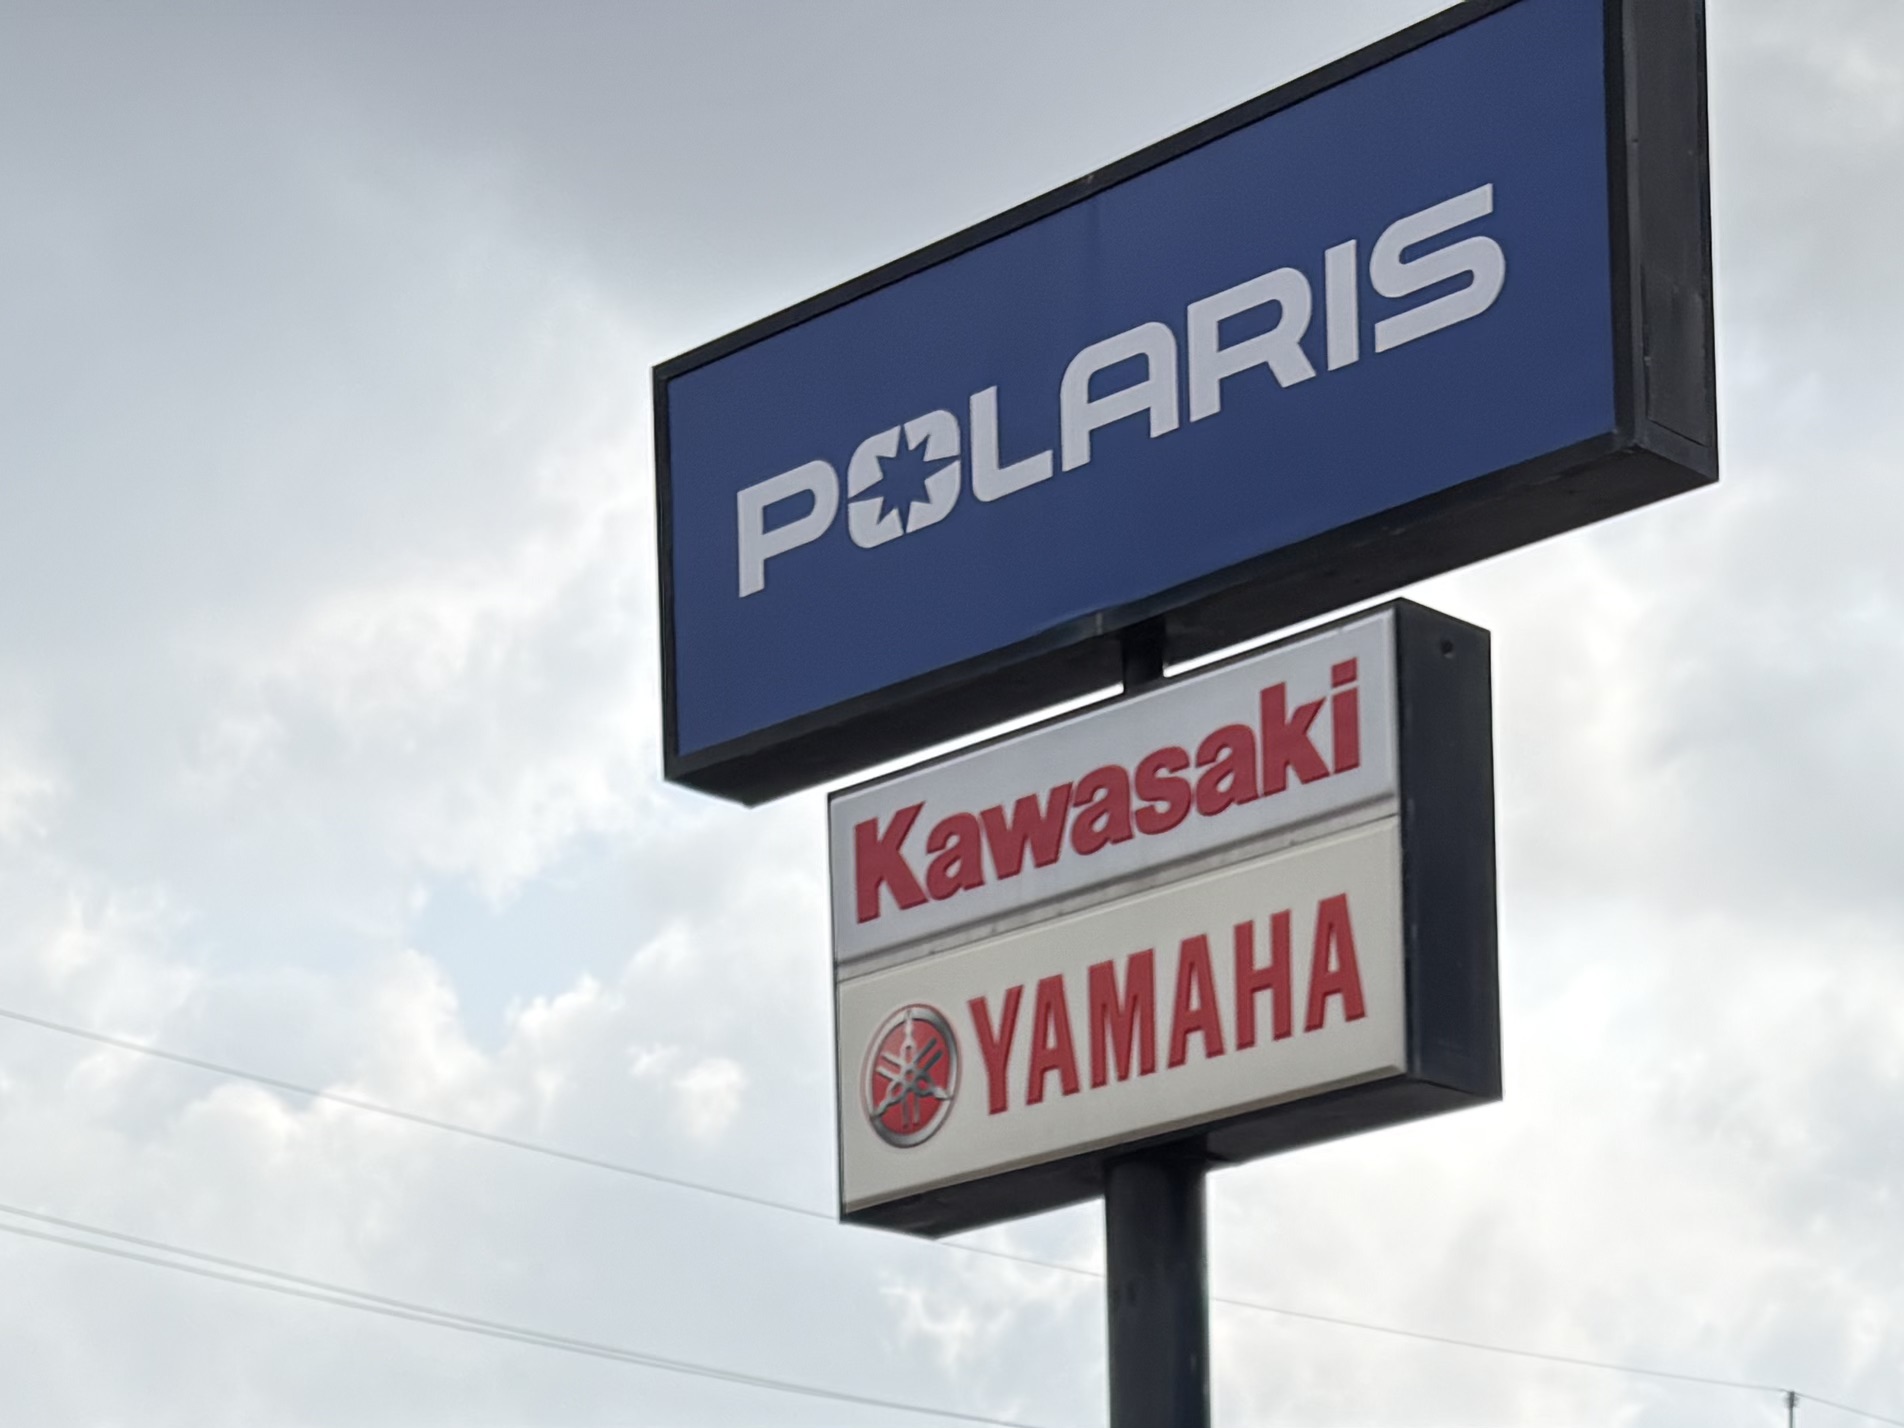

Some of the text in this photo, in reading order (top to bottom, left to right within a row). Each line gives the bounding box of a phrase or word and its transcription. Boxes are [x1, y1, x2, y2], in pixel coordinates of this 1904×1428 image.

[735, 183, 1506, 597] POLARIS
[853, 657, 1360, 923] Kawasaki
[968, 893, 1368, 1115] YAMAHA
